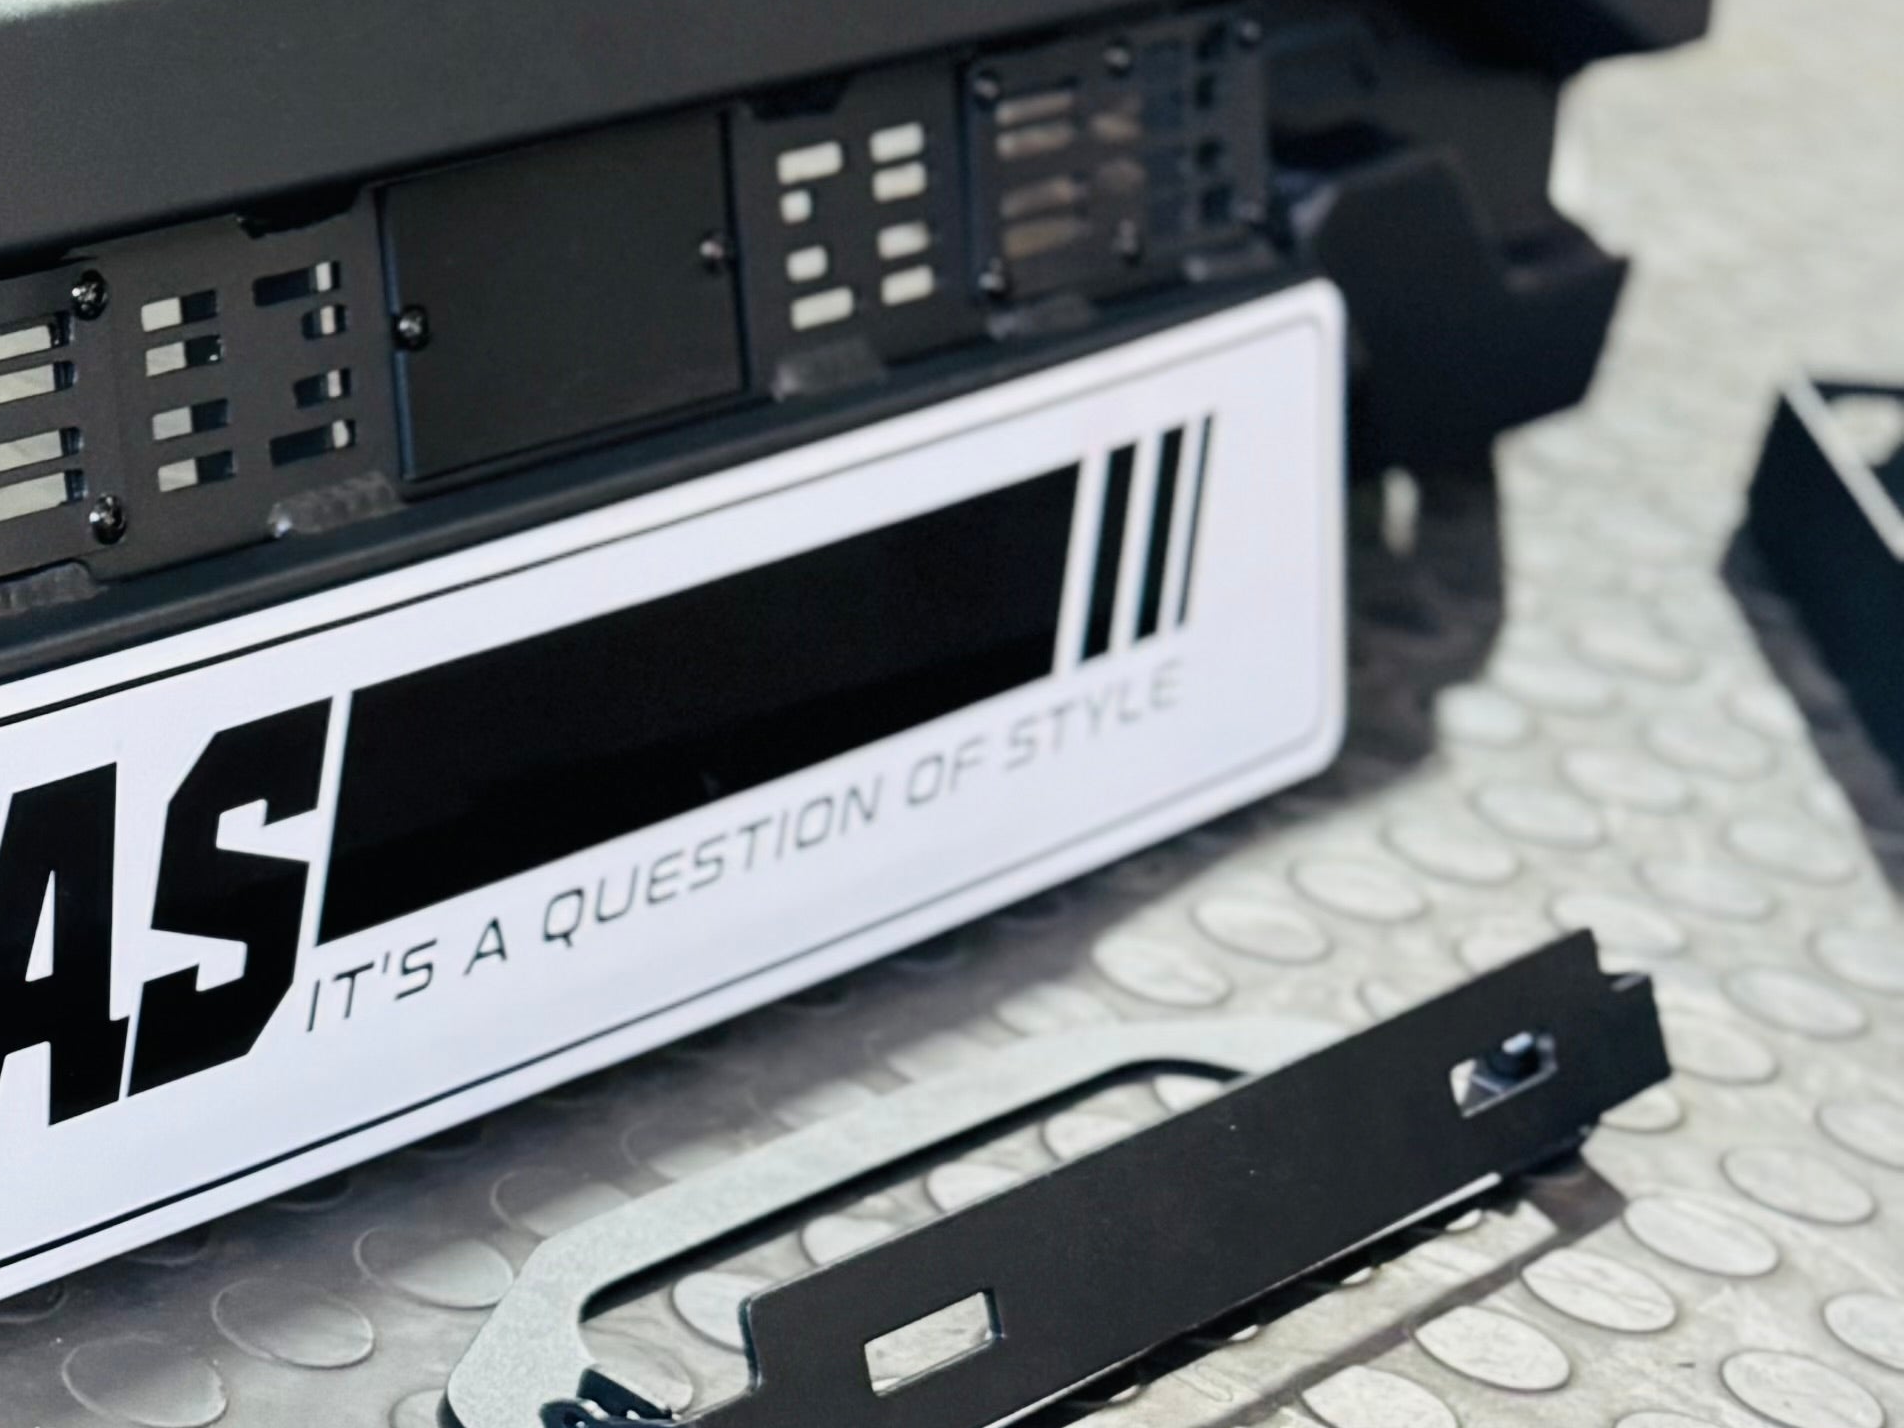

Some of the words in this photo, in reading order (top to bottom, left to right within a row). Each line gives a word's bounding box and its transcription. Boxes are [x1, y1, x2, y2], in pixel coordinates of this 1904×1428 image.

[305, 938, 438, 1033] IT'S
[463, 916, 508, 976] A
[542, 775, 883, 948] QUESTION
[905, 734, 990, 807] OF
[1003, 657, 1184, 771] STYLE
